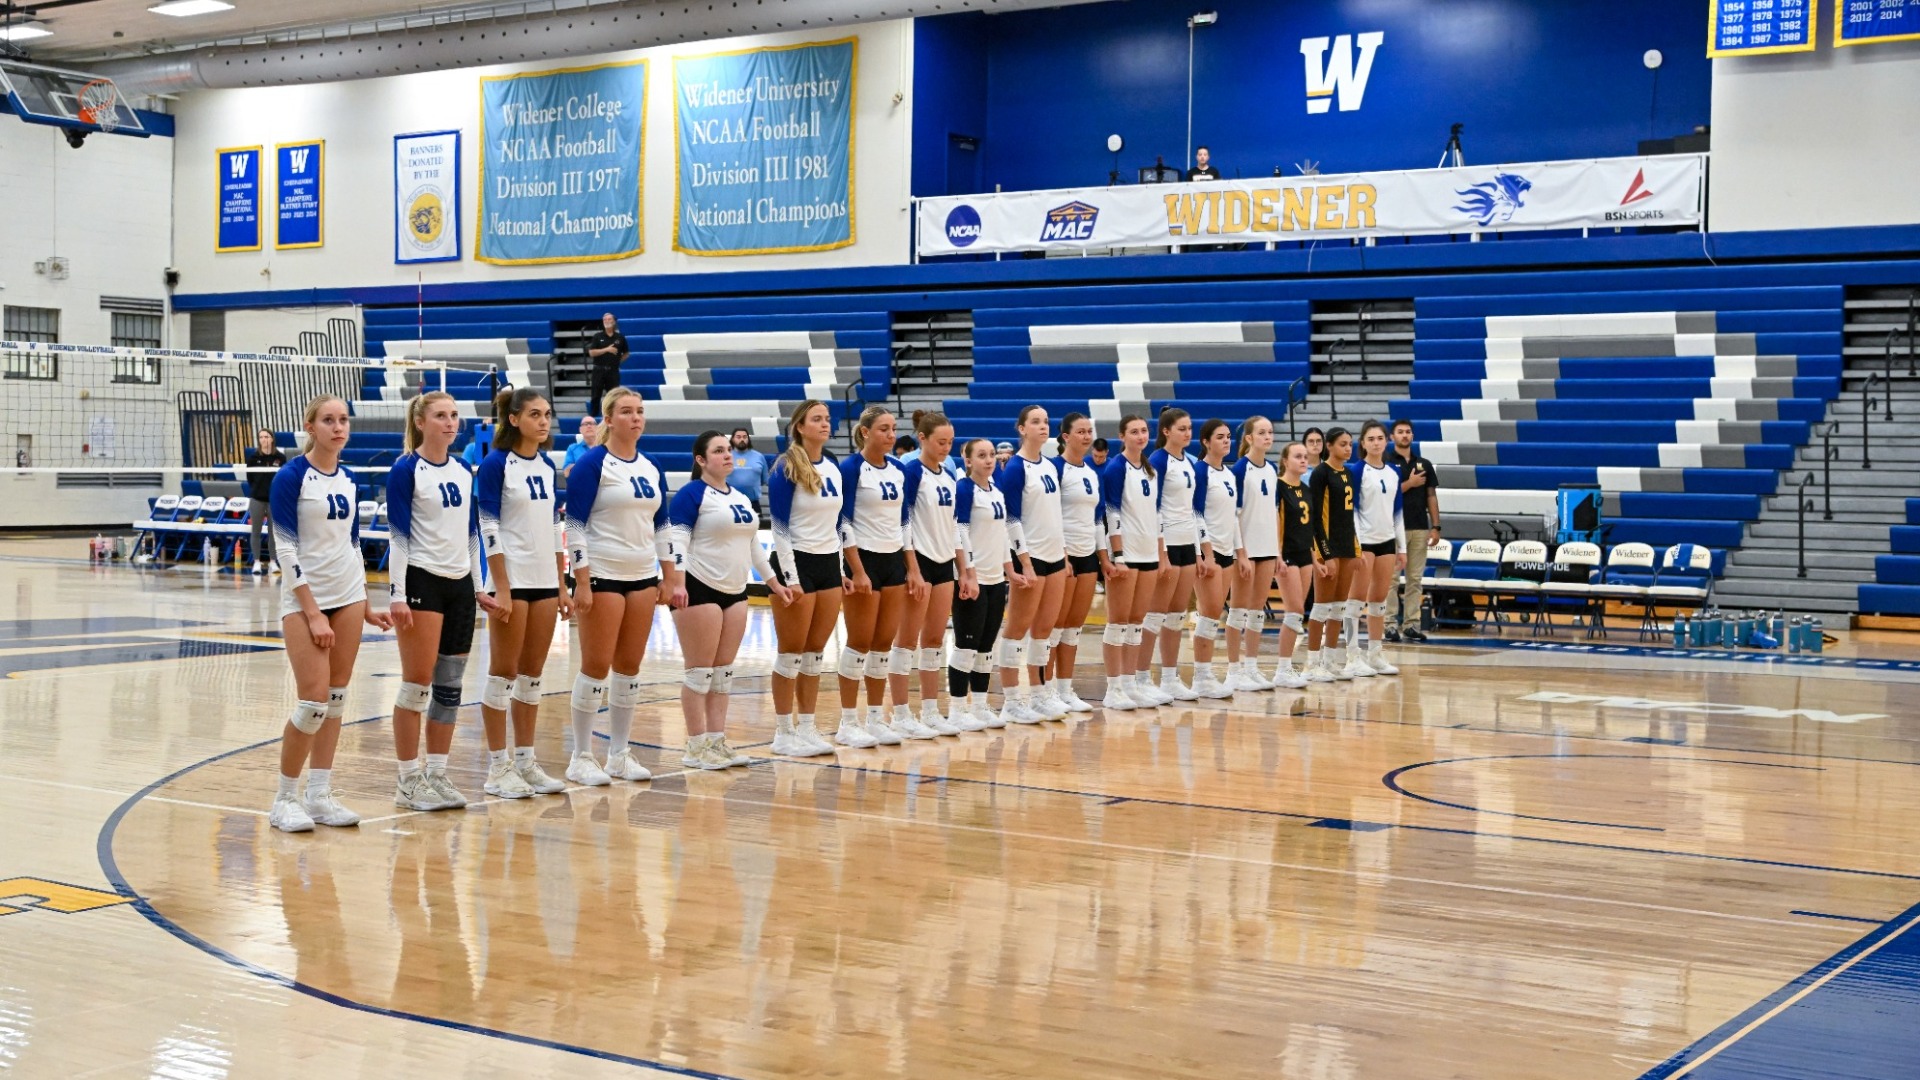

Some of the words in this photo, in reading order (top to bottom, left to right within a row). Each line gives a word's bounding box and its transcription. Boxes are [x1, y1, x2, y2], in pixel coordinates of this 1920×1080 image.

[1723, 2, 1745, 12] 1954
[1850, 1, 1873, 11] 2001
[1722, 13, 1744, 24] 1977
[1752, 11, 1773, 21] 1978
[1850, 12, 1872, 23] 2012
[1880, 10, 1903, 20] 2014
[1300, 31, 1384, 114] W
[684, 79, 753, 108] Widener
[756, 72, 840, 103] University
[502, 101, 563, 127] Widener
[567, 92, 622, 123] College
[692, 117, 747, 144] NCAA
[752, 111, 821, 142] Football
[410, 144, 443, 155] BANNERS
[500, 136, 552, 163] NCAA
[555, 128, 616, 157] Football
[230, 153, 249, 178] W
[290, 148, 310, 174] W
[408, 157, 444, 168] DONATED
[692, 161, 759, 187] Division
[764, 156, 789, 182] III
[794, 154, 829, 181] 1981
[414, 171, 423, 180] BY
[425, 169, 440, 178] THE
[497, 175, 557, 199] Division
[562, 171, 583, 195] III
[587, 167, 621, 192] 1977
[686, 199, 753, 227] National
[756, 197, 846, 228] Champions
[1163, 183, 1377, 236] WIDENER
[1604, 211, 1627, 221] BSN
[1628, 210, 1664, 220] SPORTS
[489, 211, 546, 236] National
[551, 207, 634, 238] Champions
[949, 225, 981, 238] NCAA
[1044, 220, 1094, 239] MAC
[0, 341, 18, 349] BALL
[76, 345, 116, 353] VOLLEYBALL
[526, 475, 549, 500] 17
[630, 476, 656, 499] 16
[1040, 474, 1057, 494] 10
[1082, 477, 1093, 495] 9
[1141, 479, 1151, 497] 8
[1183, 470, 1192, 489] 7
[1223, 481, 1235, 497] 5
[1260, 478, 1269, 496] 4
[1380, 479, 1387, 494] 1
[438, 481, 463, 508] 18
[880, 481, 899, 501] 13
[936, 485, 953, 507] 12
[1344, 485, 1353, 510] 2
[327, 493, 350, 519] 19
[730, 504, 753, 523] 15
[991, 501, 1004, 520] 11
[1299, 500, 1309, 525] 3
[1466, 545, 1498, 554] Widener
[1509, 545, 1542, 555] Widener
[1562, 547, 1597, 557] Widener
[1616, 549, 1650, 559] Widener
